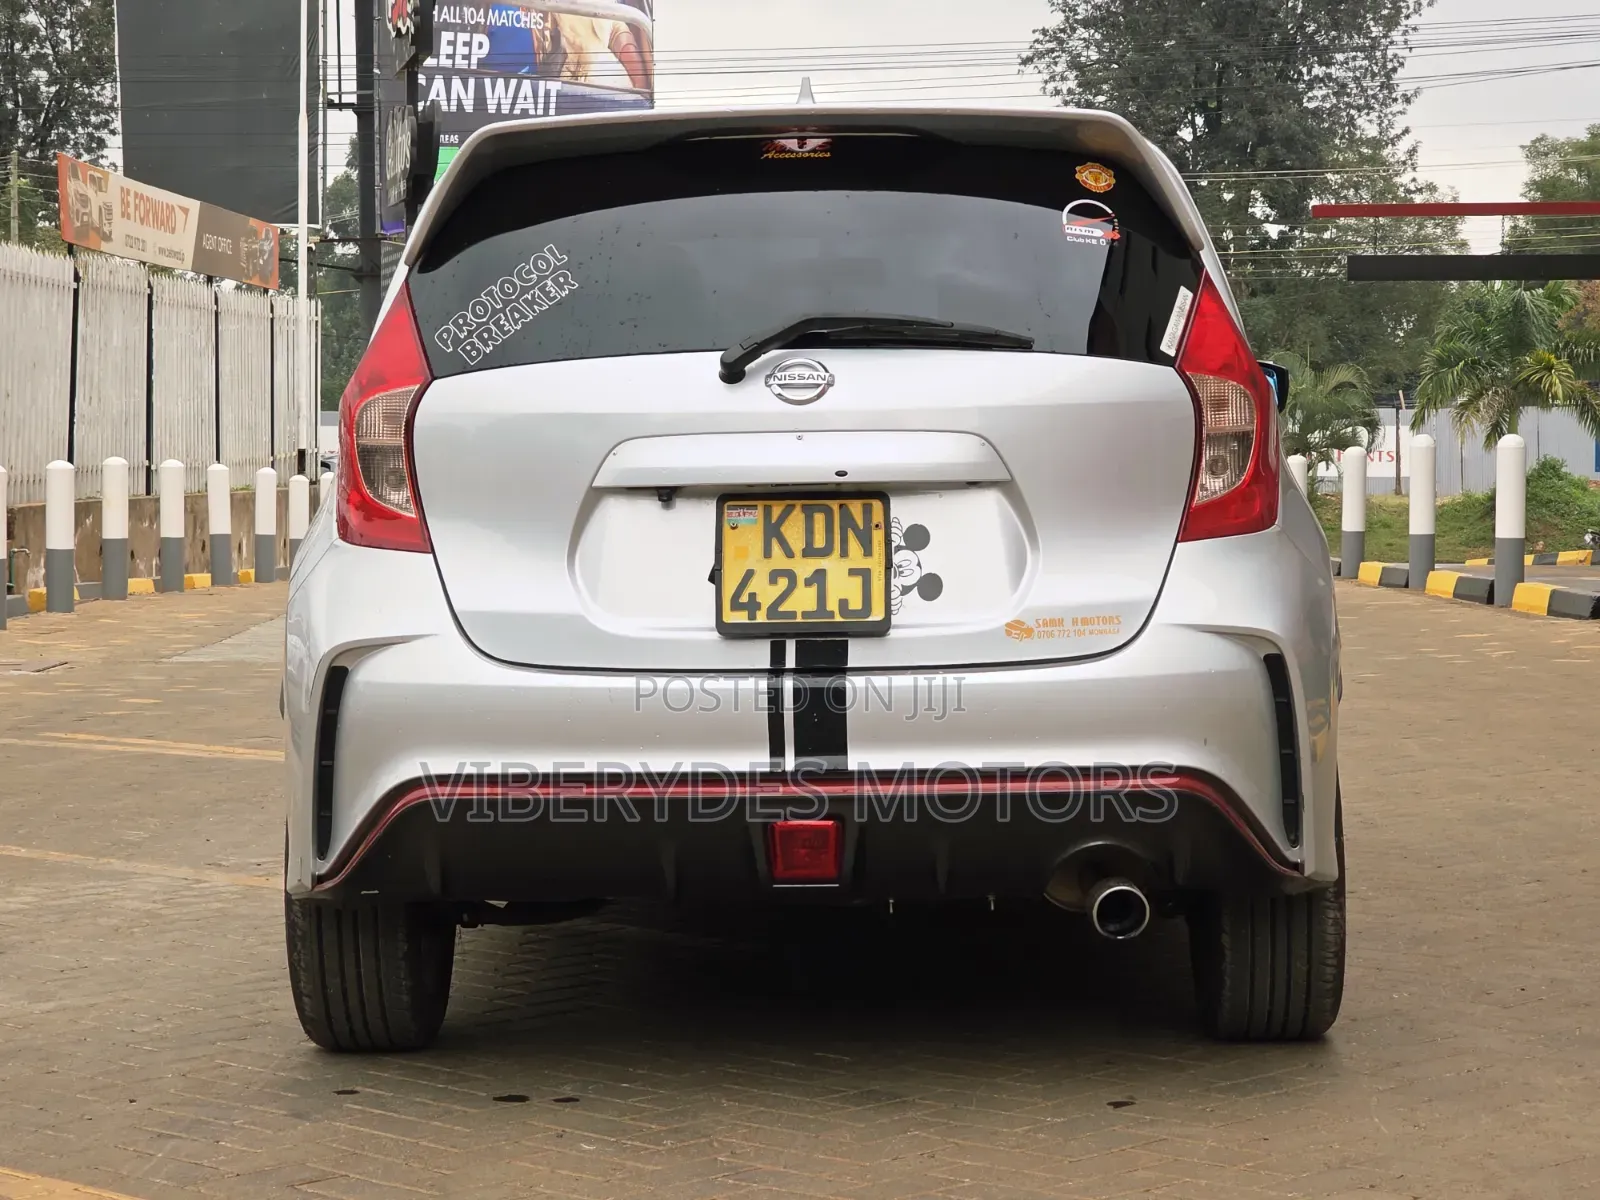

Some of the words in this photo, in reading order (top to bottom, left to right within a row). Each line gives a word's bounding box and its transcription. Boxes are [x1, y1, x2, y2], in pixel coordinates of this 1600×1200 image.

[440, 5, 462, 24] ALL
[463, 7, 485, 25] 104
[487, 8, 544, 29] MATCHES
[484, 77, 562, 116] WAIT
[450, 134, 459, 144] AS
[760, 150, 831, 159] Accessories
[120, 186, 131, 221] BE
[133, 191, 177, 235] FORWARD
[203, 233, 217, 251] AGENT
[217, 236, 232, 255] OFFICE
[434, 243, 568, 352] PROTOCOL
[458, 270, 579, 365] BREAKER
[773, 373, 827, 382] NISSAN
[763, 502, 873, 559] KDN
[730, 567, 873, 621] 421J
[1057, 629, 1071, 638] 772
